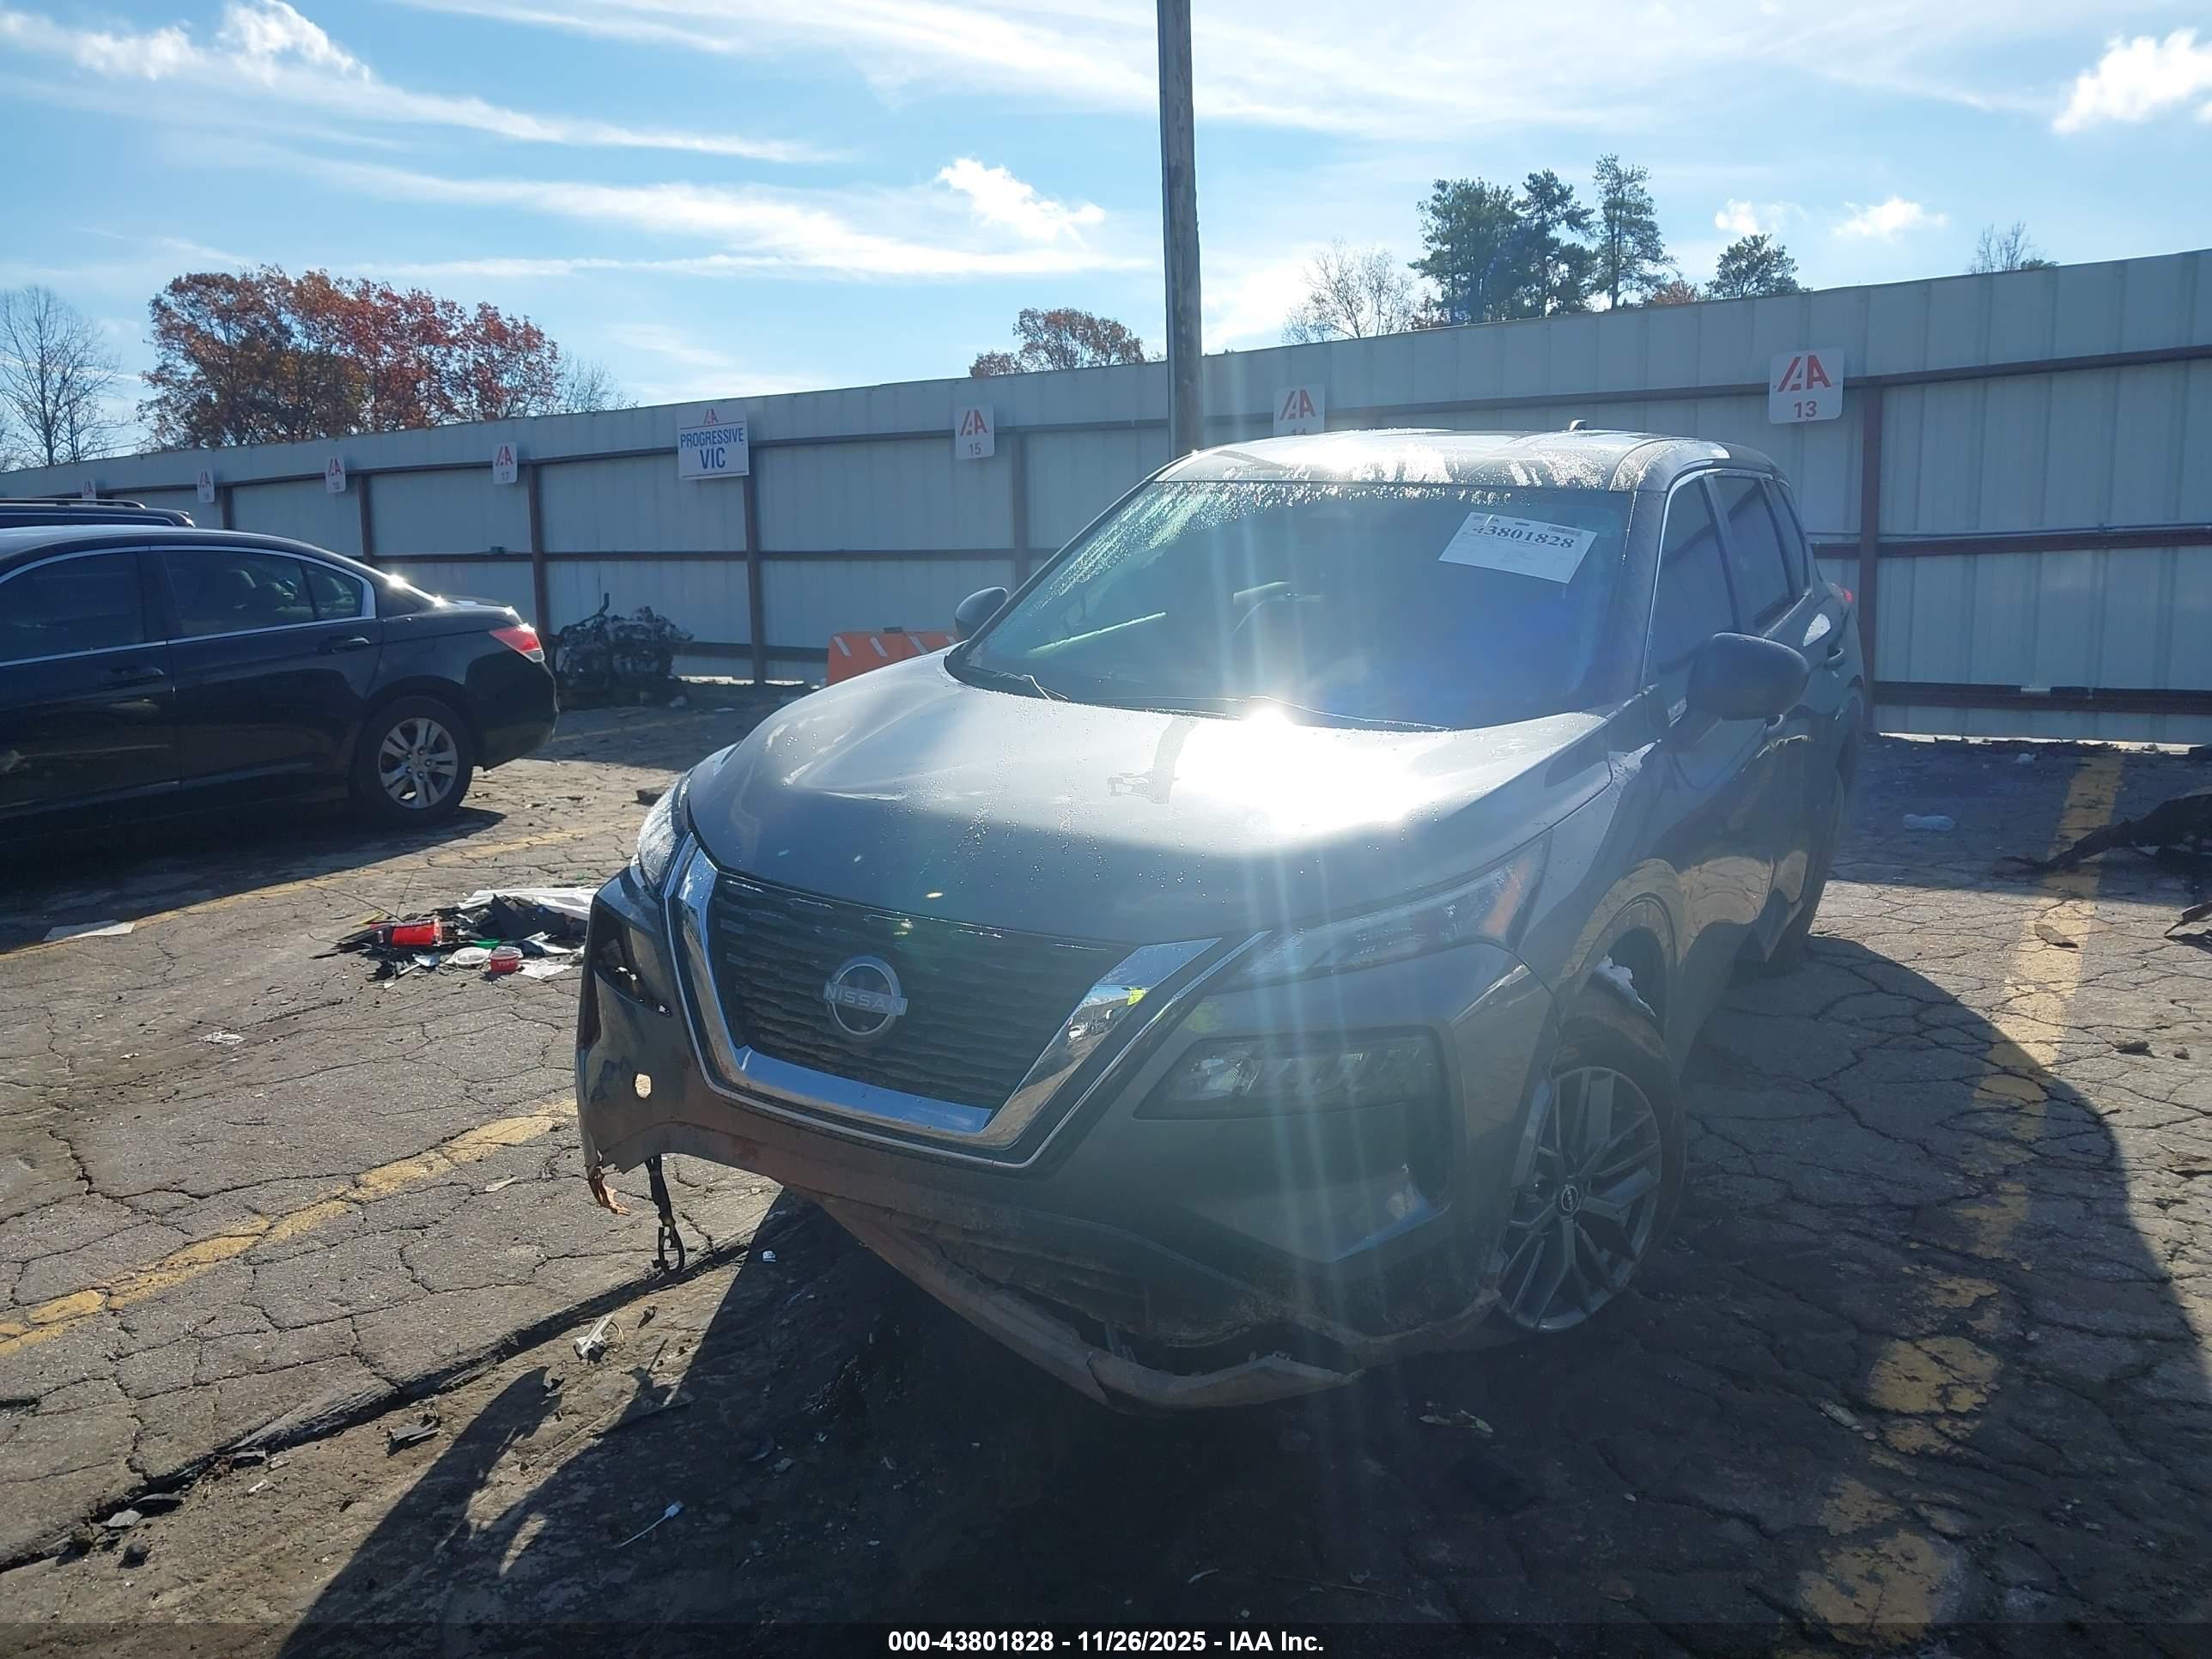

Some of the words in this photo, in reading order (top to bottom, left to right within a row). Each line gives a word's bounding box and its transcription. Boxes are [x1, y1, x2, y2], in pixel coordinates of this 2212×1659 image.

[1794, 400, 1818, 418] 13
[680, 428, 744, 448] PROGRESSIVE
[700, 447, 726, 469] VIC
[969, 442, 981, 455] 15
[825, 985, 904, 1012] NISSAN
